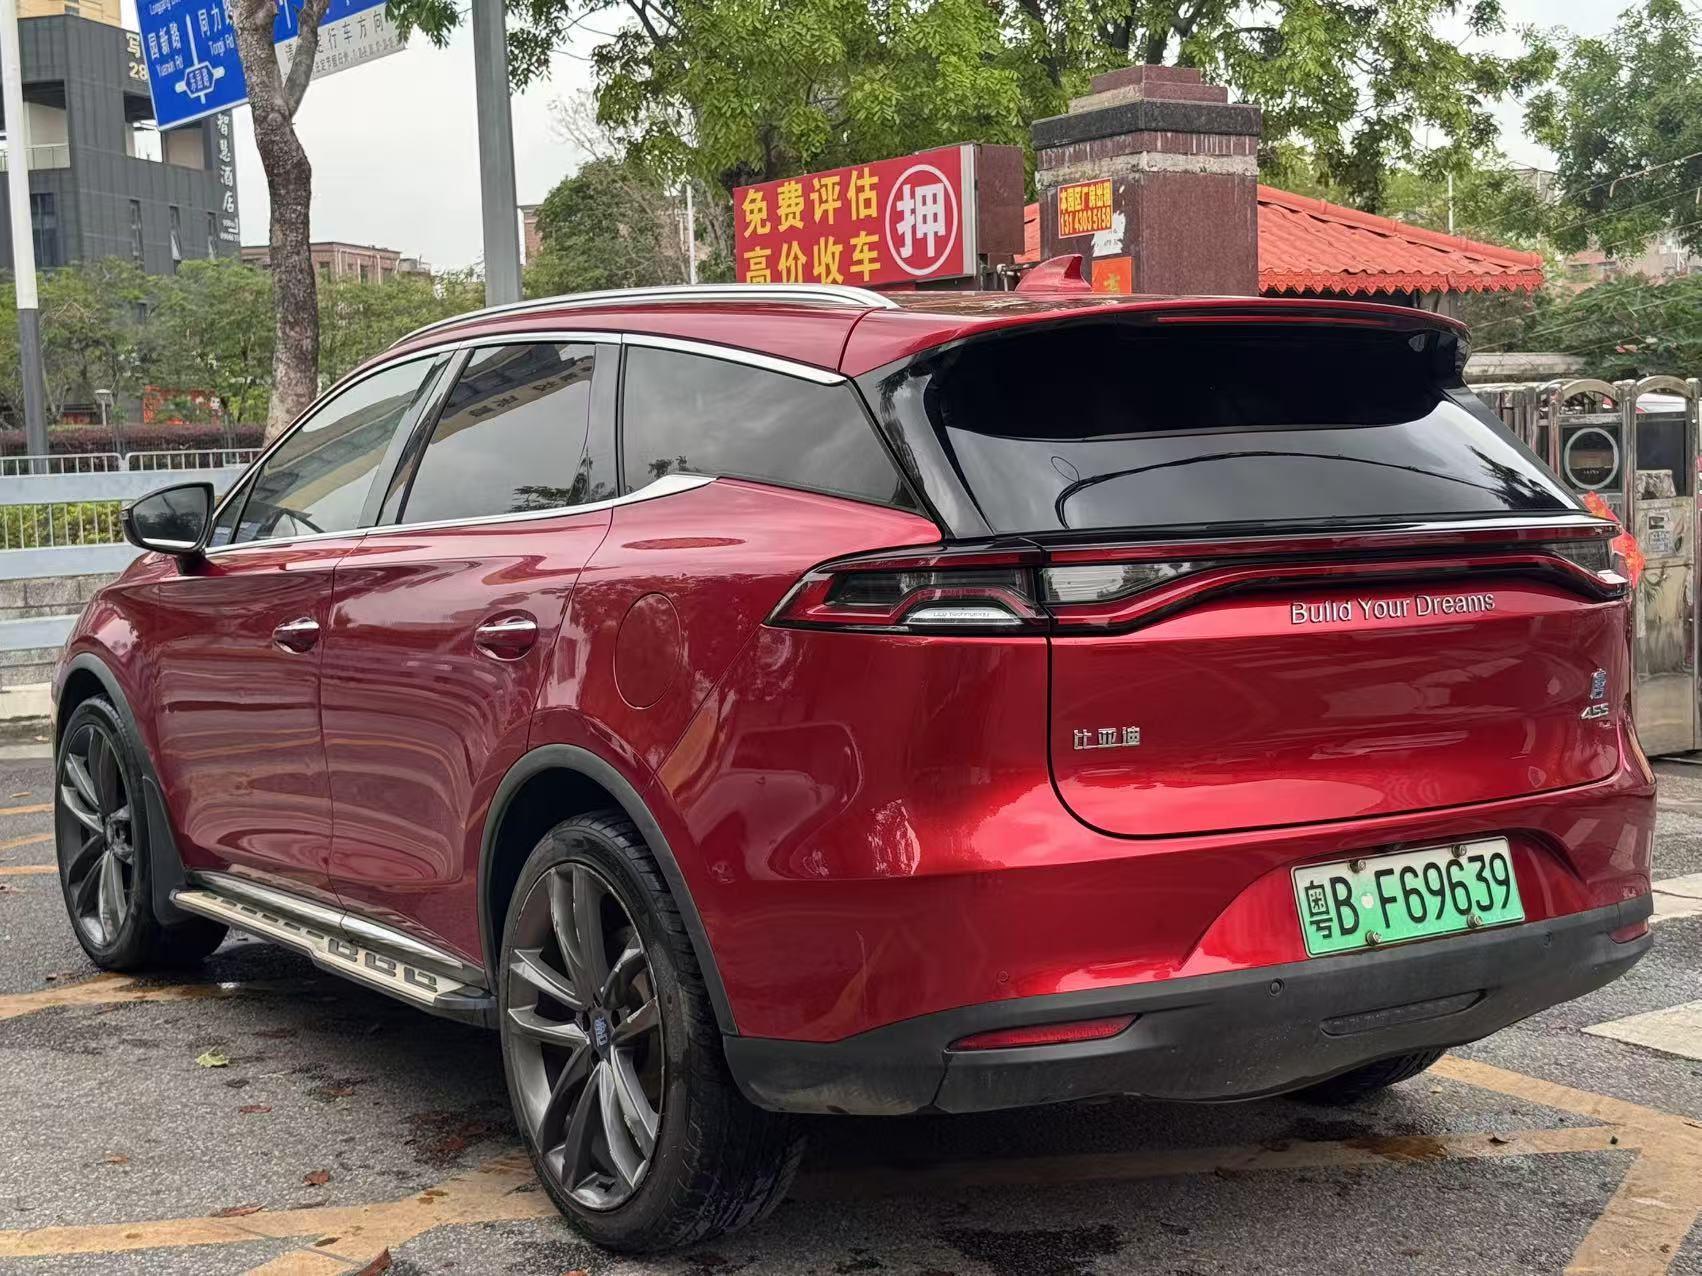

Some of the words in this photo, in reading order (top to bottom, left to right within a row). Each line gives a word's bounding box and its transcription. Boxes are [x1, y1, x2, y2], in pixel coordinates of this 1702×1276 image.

[217, 113, 235, 213] 智慧酒店
[741, 167, 881, 239] 免费评估
[896, 183, 946, 259] 押
[743, 231, 881, 284] 高价收车
[1291, 599, 1352, 625] Build
[1356, 597, 1411, 620] Your
[1414, 593, 1496, 617] Dreams
[1073, 725, 1140, 750] 比亚迪
